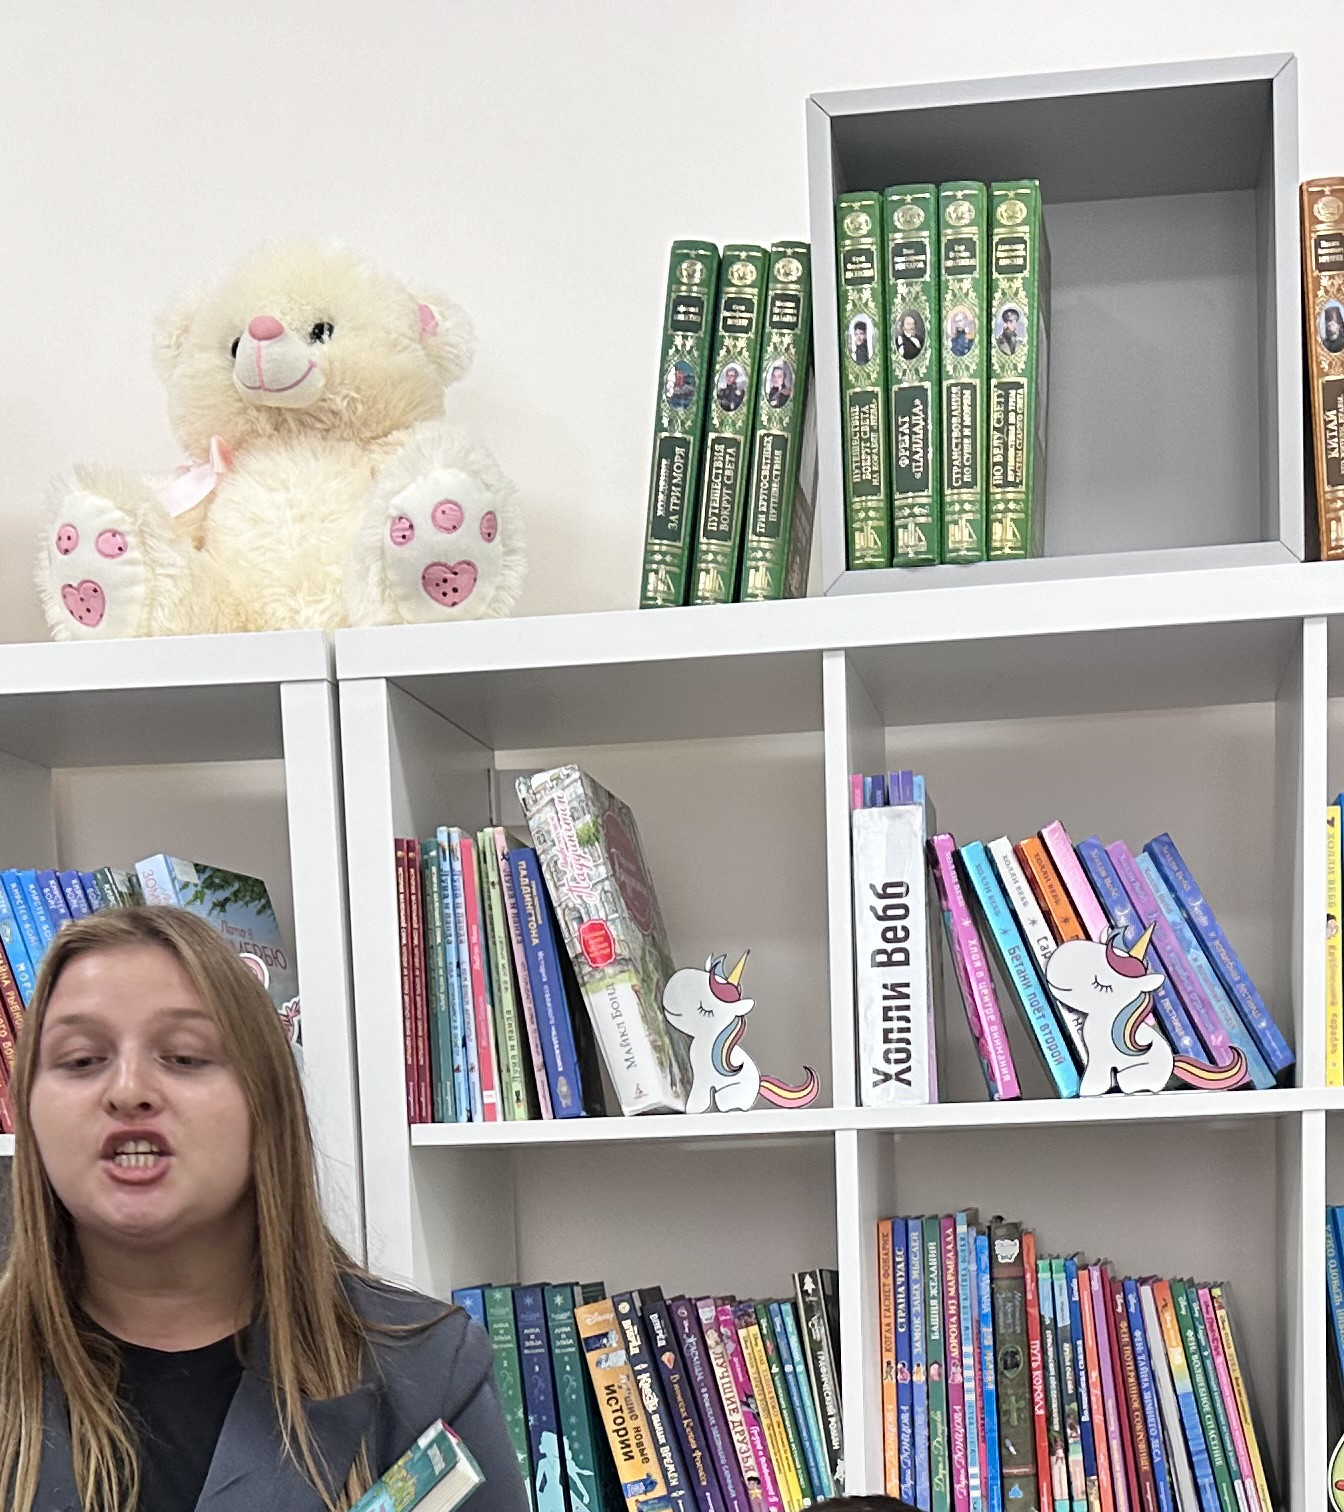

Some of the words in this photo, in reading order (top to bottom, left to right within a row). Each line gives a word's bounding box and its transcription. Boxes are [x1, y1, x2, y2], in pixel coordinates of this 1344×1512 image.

[992, 389, 1004, 428] СВЕТУ
[897, 416, 910, 467] ФРЕГАТ
[911, 399, 924, 479] «ПАЛЛАДА»
[951, 386, 962, 486] СТРАНСТВОВАНИЯ
[1324, 410, 1339, 457] КИТАЙ
[673, 447, 686, 485] МОРЯ
[709, 444, 725, 531] ПУТЕШЕСТВИЯ
[724, 448, 736, 485] СВЕТА
[992, 465, 1003, 484] ПО
[667, 513, 680, 530] ЗА
[670, 488, 682, 511] ТРИ
[720, 488, 734, 531] ВОКРУГ
[869, 881, 910, 968] Вебб
[1008, 946, 1033, 990] Бетани
[1026, 992, 1046, 1019] поёт
[871, 981, 912, 1088] Холли
[894, 1247, 906, 1285] ЧУДЕС
[926, 1242, 938, 1297] ЖЕЛАНИЙ
[896, 1288, 907, 1332] СТРАНА
[929, 1300, 939, 1339] БАШНЯ
[601, 1384, 637, 1463] истории
[712, 1351, 740, 1417] ЛУЧШИЕ
[727, 1420, 757, 1475] ДРУЗЬЯ
[817, 1351, 835, 1415] ГРАФИЧЕСКИЙ
[826, 1418, 841, 1449] РОМАН
